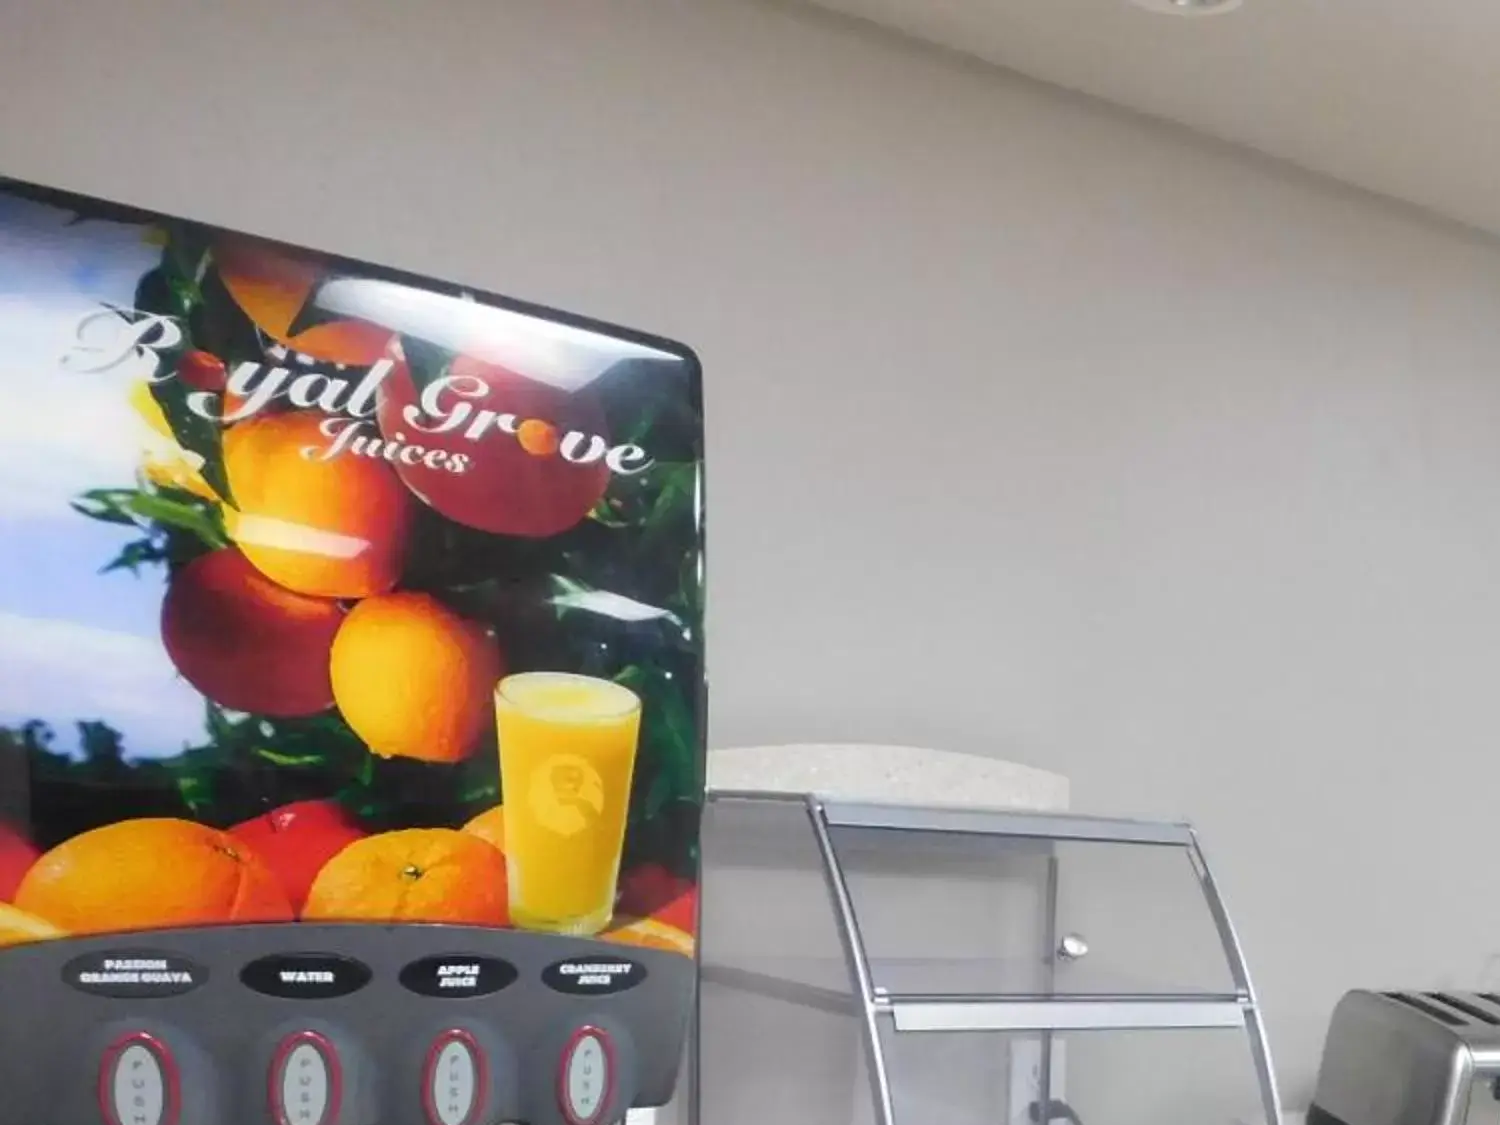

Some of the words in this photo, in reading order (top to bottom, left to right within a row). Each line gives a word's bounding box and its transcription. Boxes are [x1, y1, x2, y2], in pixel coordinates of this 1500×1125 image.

[402, 375, 655, 475] Grove
[300, 416, 472, 474] Juices
[437, 965, 480, 976] APPLE
[559, 963, 632, 974] CRANBERRY
[279, 971, 335, 983] WATER
[438, 976, 477, 988] JUICE
[577, 974, 611, 985] JUICE
